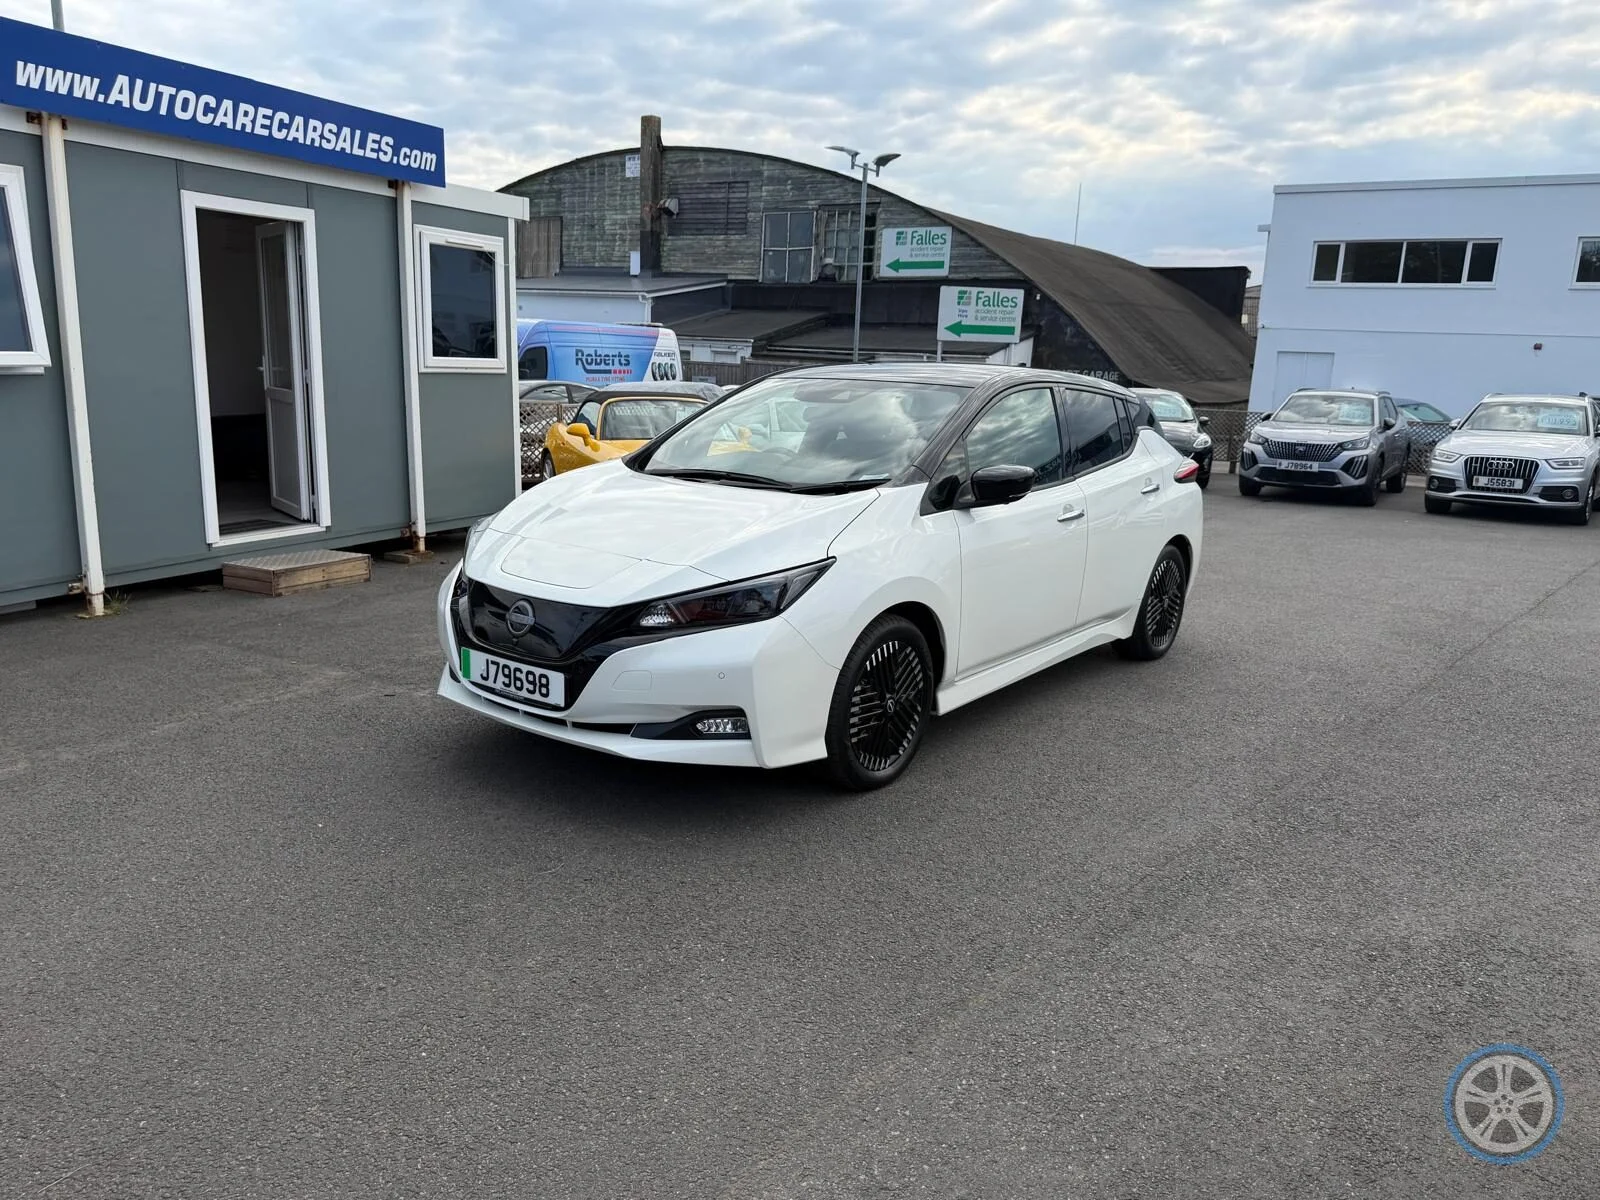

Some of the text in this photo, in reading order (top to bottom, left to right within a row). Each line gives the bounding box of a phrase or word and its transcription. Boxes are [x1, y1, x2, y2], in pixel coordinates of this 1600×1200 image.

[16, 60, 437, 172] www.AUTOCARECARSALES.com
[910, 229, 947, 246] Falles
[975, 290, 1018, 309] Falles
[575, 348, 631, 367] Roberts
[1082, 369, 1121, 381] GARAGE
[1284, 461, 1313, 470] J78964
[1484, 478, 1515, 488] J55831
[480, 658, 550, 698] J79698
